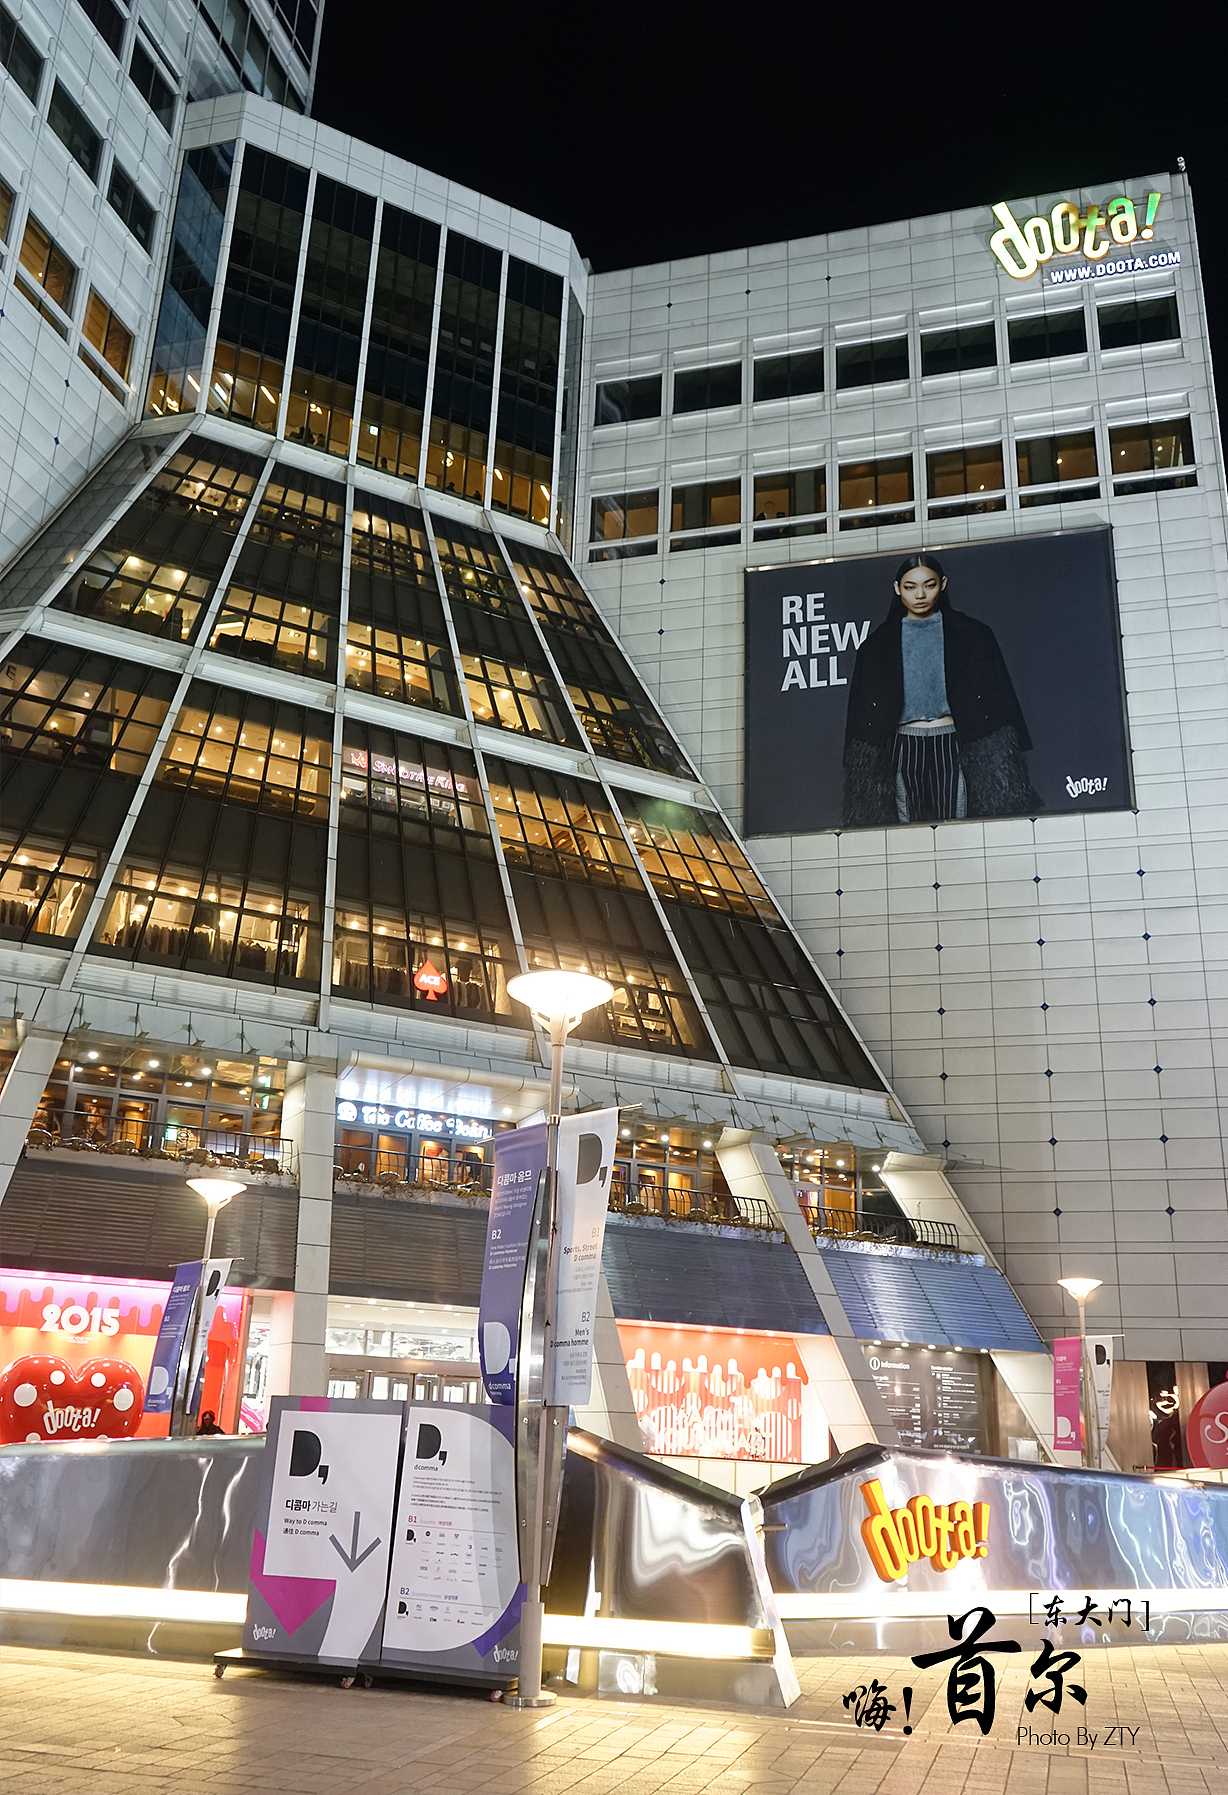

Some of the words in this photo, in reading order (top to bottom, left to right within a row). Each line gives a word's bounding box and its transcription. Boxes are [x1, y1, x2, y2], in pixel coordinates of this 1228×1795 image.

[989, 192, 1161, 280] doota!
[1050, 251, 1181, 284] WWW.DOOTA.COM
[782, 592, 826, 626] RE
[782, 620, 871, 658] NEW
[781, 655, 848, 692] ALL
[372, 760, 435, 787] SMOOTHE
[1065, 775, 1109, 799] doota!
[418, 973, 441, 986] ACE
[497, 1172, 517, 1187] 디콤마
[517, 1169, 532, 1183] 옴므
[491, 1229, 502, 1240] B2
[591, 1227, 600, 1238] B1
[563, 1246, 581, 1256] Sports,
[582, 1242, 598, 1252] Street
[573, 1254, 578, 1262] D
[578, 1253, 597, 1262] comma
[40, 1303, 120, 1336] 2015
[581, 1311, 590, 1322] B2
[575, 1328, 589, 1337] Men's
[554, 1339, 571, 1348] comma
[571, 1338, 588, 1347] homme
[881, 1361, 910, 1370] Information
[43, 1400, 101, 1434] doota!
[415, 1423, 448, 1466] D,
[289, 1430, 330, 1485] D,
[285, 1499, 311, 1512] 디콤마
[312, 1501, 338, 1513] 가는길
[284, 1518, 295, 1526] Way
[307, 1519, 328, 1527] comma
[408, 1515, 417, 1523] B1
[859, 1478, 991, 1583] doota!
[400, 1587, 410, 1596] B2
[252, 1623, 277, 1641] doota!
[493, 1645, 519, 1663] doota!
